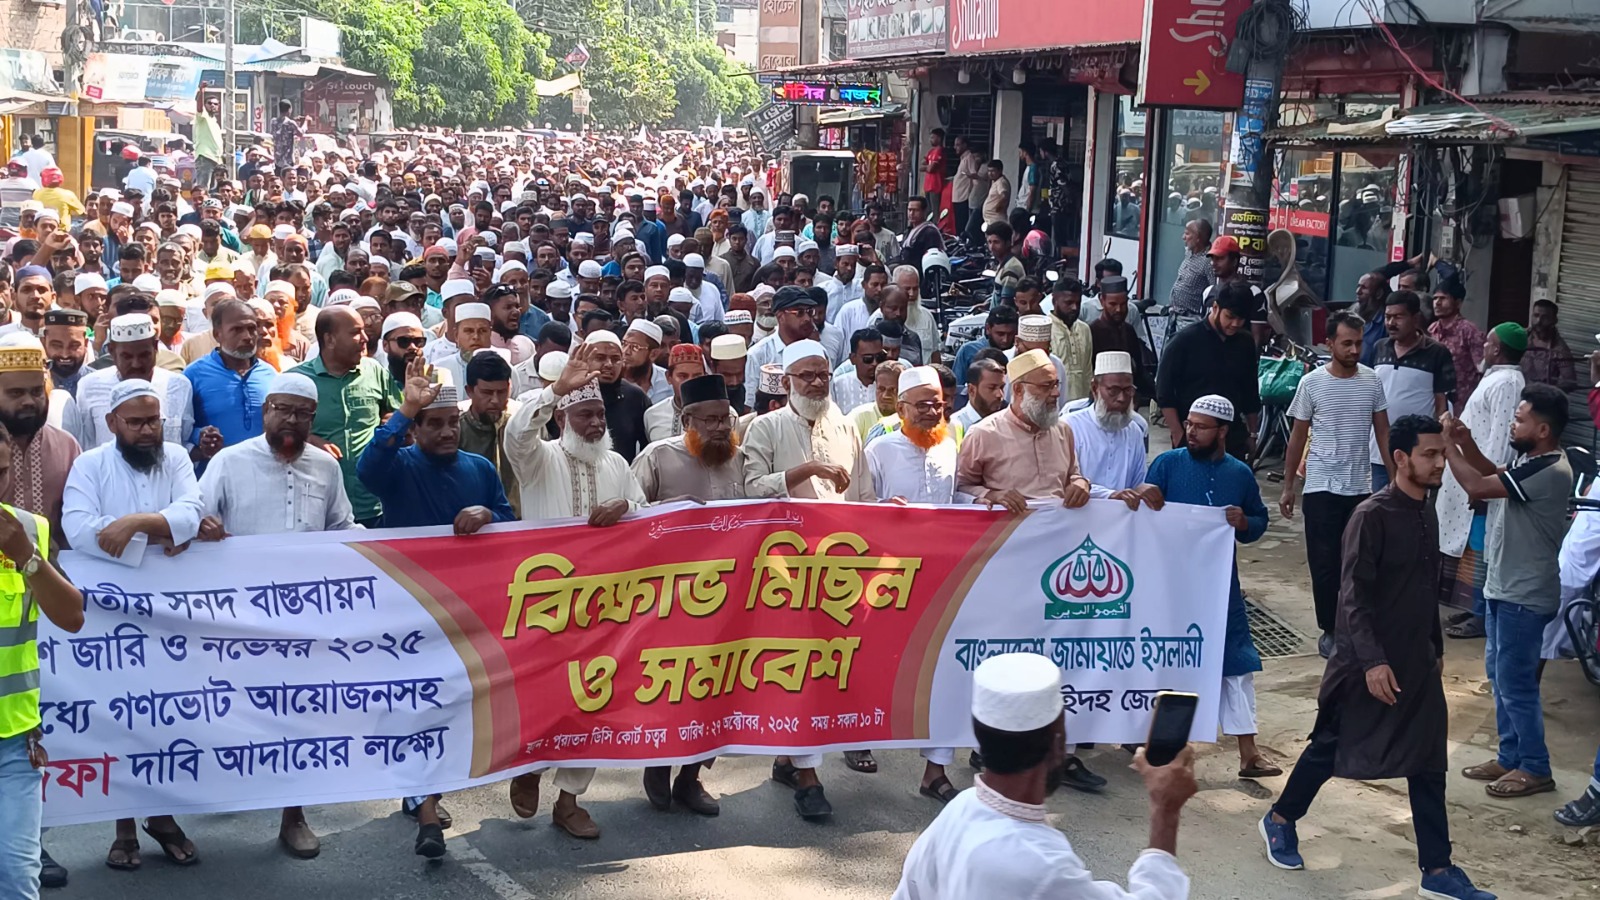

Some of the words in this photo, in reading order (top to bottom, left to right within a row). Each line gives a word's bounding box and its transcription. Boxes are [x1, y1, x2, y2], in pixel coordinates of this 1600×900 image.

[952, 0, 999, 49] Shwapno
[79, 582, 155, 618] াতীয়
[160, 588, 238, 621] সনদ
[245, 575, 377, 617] বাস্তবায়ন
[502, 552, 736, 638] বিক্ষোভ
[745, 530, 922, 626] মিছিল
[67, 622, 150, 672] জারি
[160, 634, 188, 662] ও
[200, 636, 317, 662] নভেম্বর
[328, 630, 427, 662] ২০২৫
[1050, 636, 1135, 671] জামায়াতে
[1140, 623, 1204, 671] ইসলামী
[567, 655, 618, 713] ও
[634, 636, 861, 705] সমাবেশ
[1060, 684, 1113, 714] ইদহ
[38, 699, 97, 735] ধ্যে
[108, 676, 237, 731] গণভোট
[245, 677, 445, 718] আয়োজনসহ
[553, 732, 588, 751] পুরাতন
[590, 727, 614, 743] ডিসি
[616, 724, 643, 746] কোর্ট
[644, 727, 668, 750] চত্বর
[678, 720, 704, 741] তারিখ
[768, 715, 800, 733] ২০২৫
[811, 715, 830, 730] সময়
[874, 708, 885, 727] টা
[42, 751, 120, 803] ফা
[126, 738, 205, 786] দাবি
[212, 735, 354, 777] আদায়ের
[364, 727, 451, 769] লক্ষ্যে
